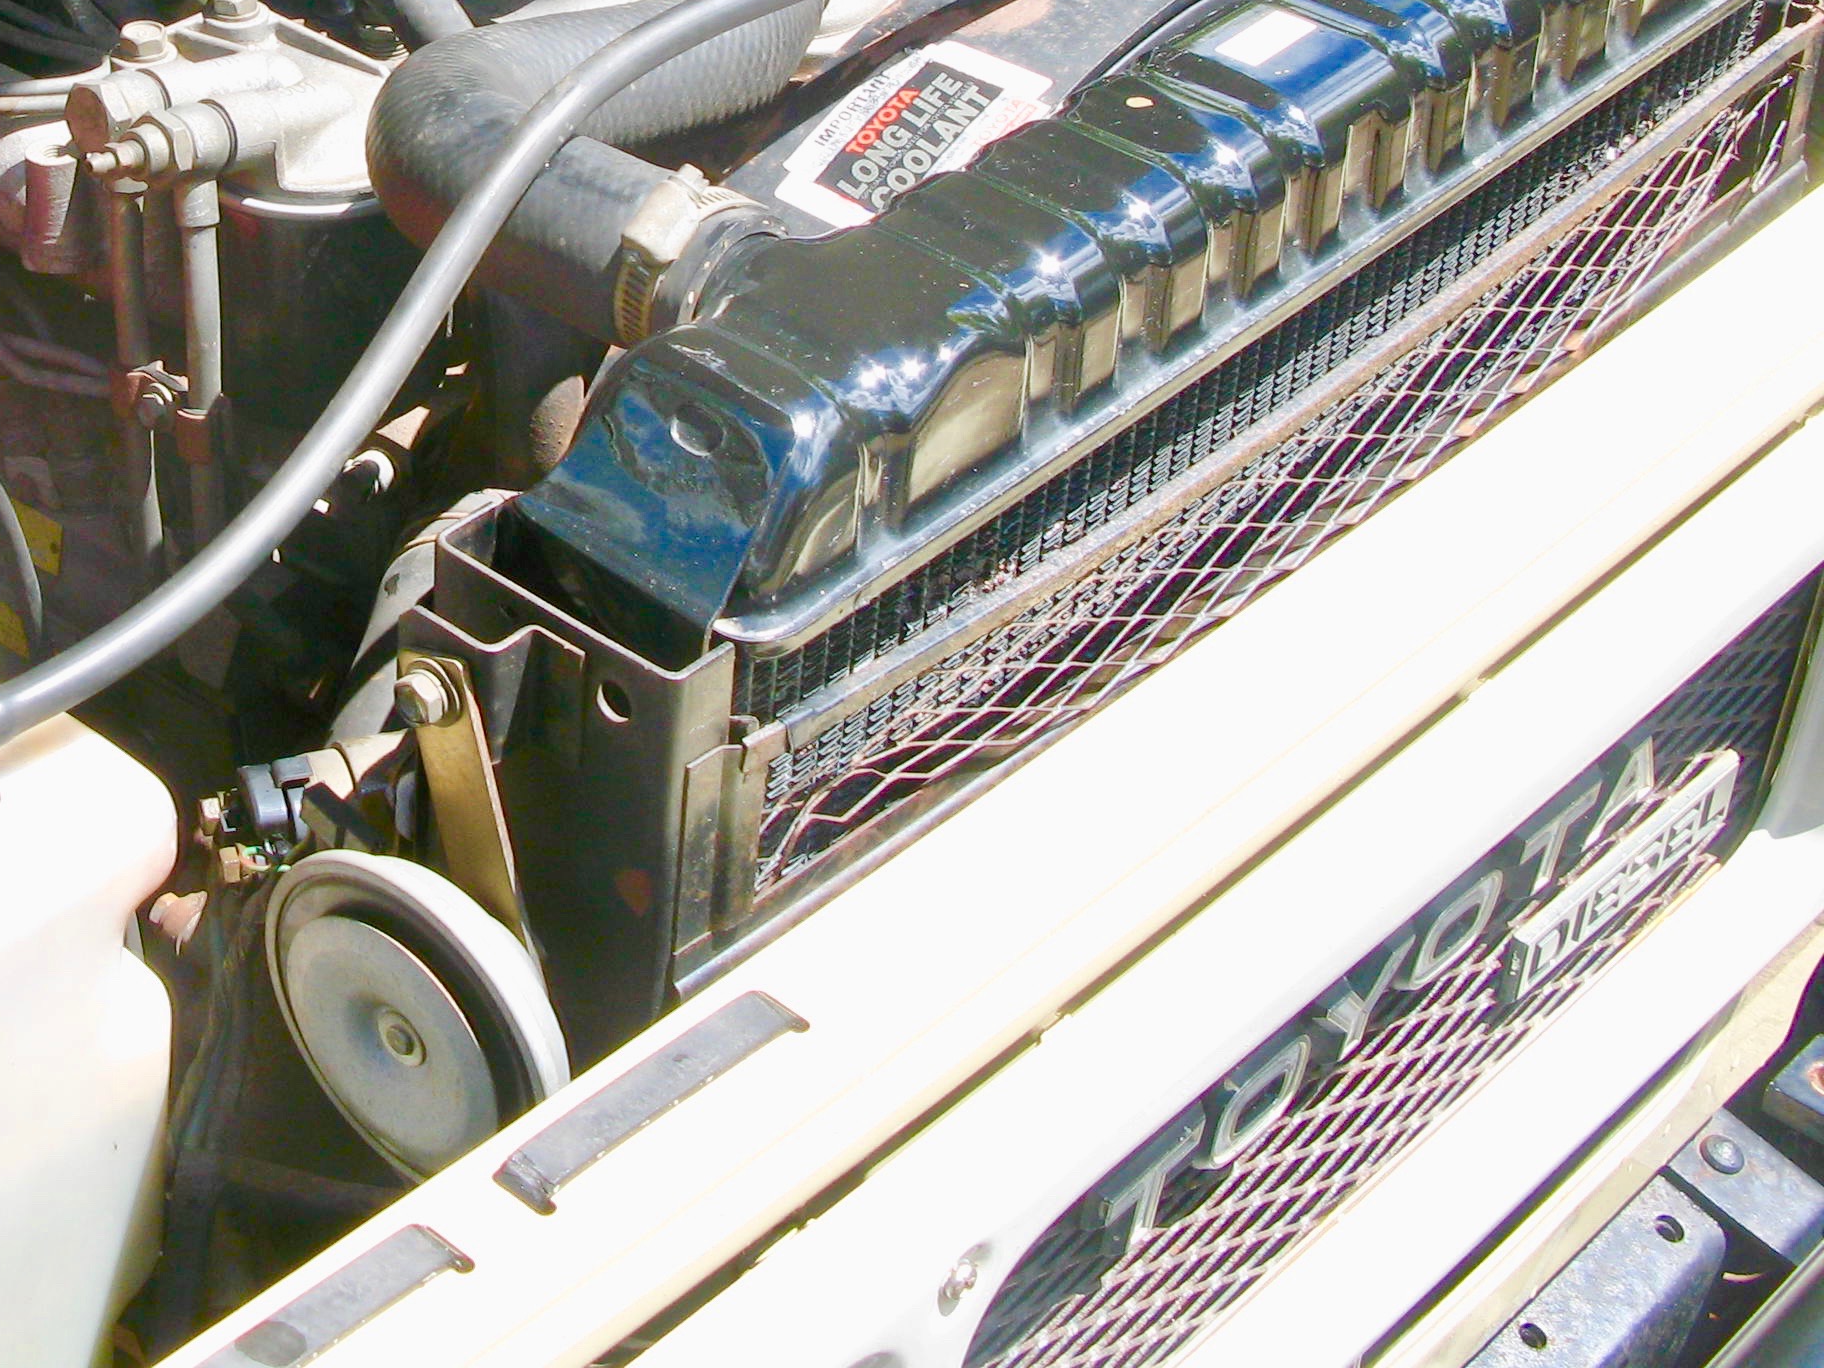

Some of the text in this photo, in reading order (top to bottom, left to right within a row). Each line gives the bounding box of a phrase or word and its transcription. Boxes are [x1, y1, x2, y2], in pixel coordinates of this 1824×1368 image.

[836, 125, 913, 200] LONG
[901, 72, 964, 129] LIFE
[845, 88, 921, 153] TOYOTA
[871, 84, 992, 208] COOLANT
[1528, 787, 1730, 989] DIESEL
[1102, 737, 1658, 1252] TOYOTA
